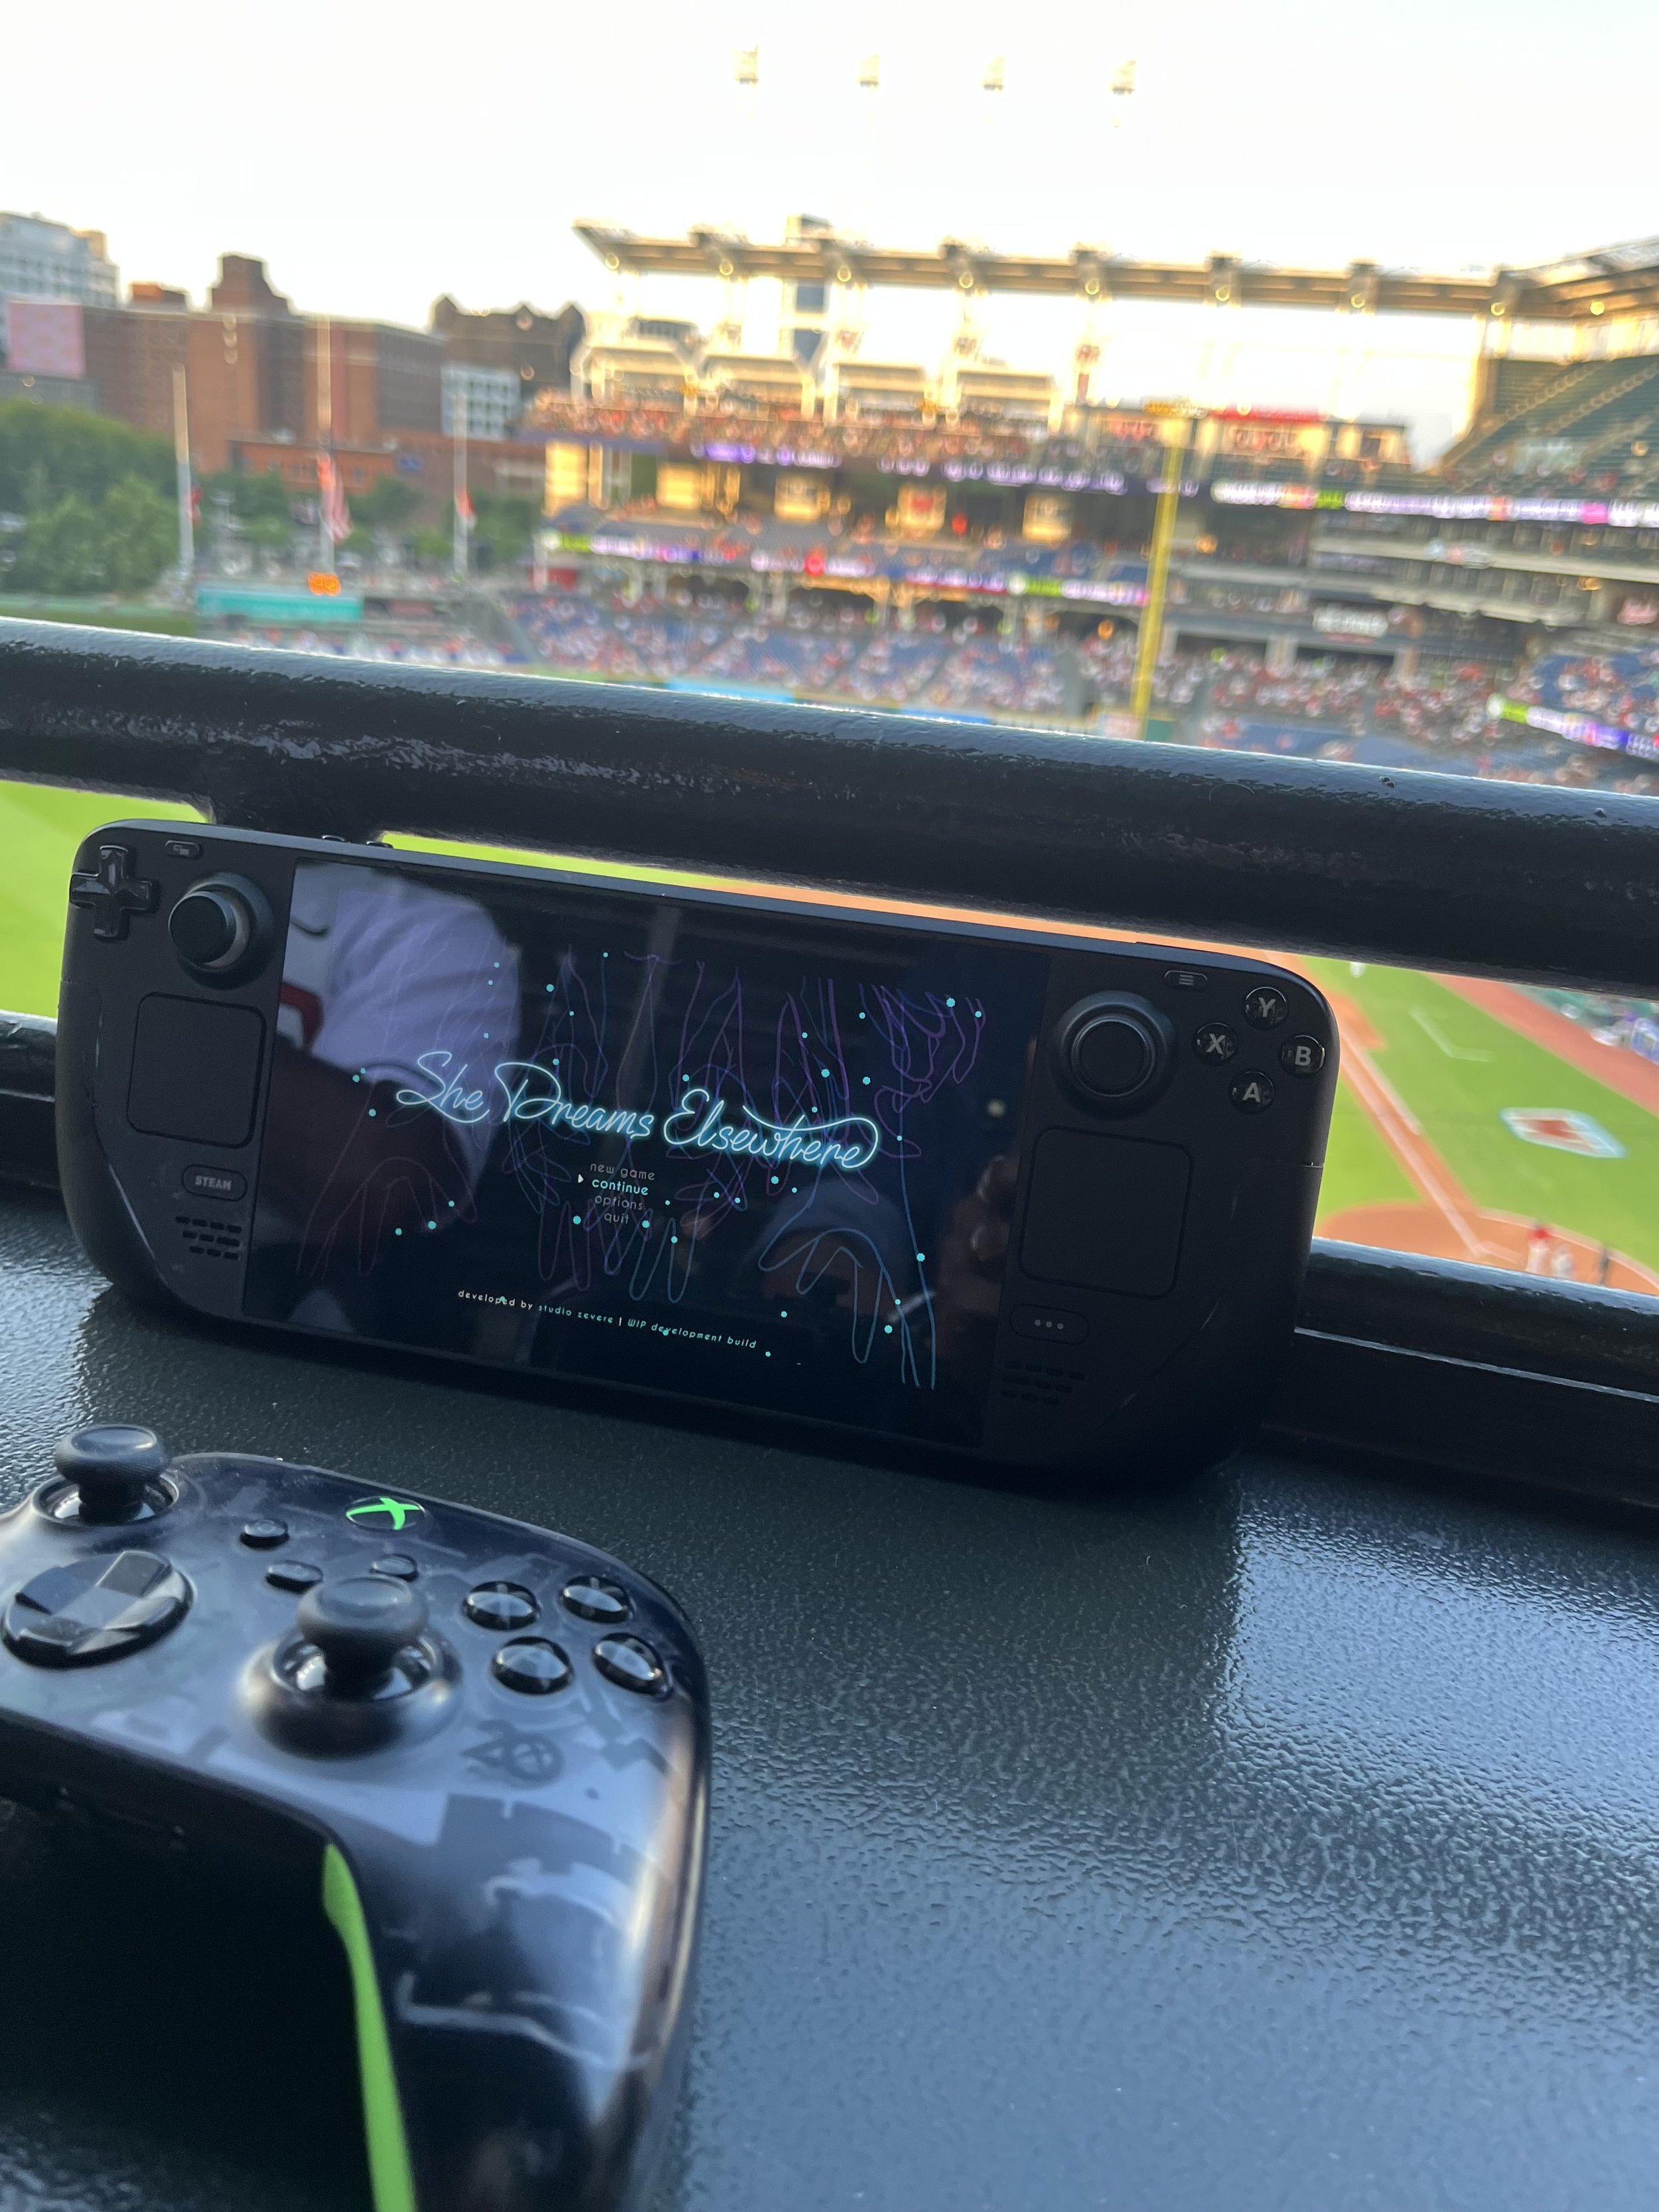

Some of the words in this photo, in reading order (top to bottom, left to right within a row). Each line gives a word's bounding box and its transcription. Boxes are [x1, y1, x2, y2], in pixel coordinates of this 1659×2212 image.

[1258, 997, 1276, 1017] Y
[1207, 1033, 1226, 1055] X
[1295, 1046, 1311, 1066] B
[1242, 1082, 1261, 1102] A
[397, 1051, 490, 1123] She
[494, 1063, 654, 1138] Dreams
[664, 1088, 879, 1168] Elsewhere
[591, 1163, 614, 1174] new
[620, 1167, 655, 1181] game
[195, 1176, 232, 1191] STEAM
[592, 1179, 648, 1195] continue
[595, 1195, 643, 1211] options
[604, 1213, 629, 1224] quit
[459, 1290, 515, 1306] developed
[521, 1300, 534, 1310] by
[538, 1305, 571, 1316] studio
[578, 1311, 613, 1323] zevere
[628, 1319, 646, 1328] WIP
[651, 1323, 722, 1342] development
[727, 1336, 757, 1349] build
